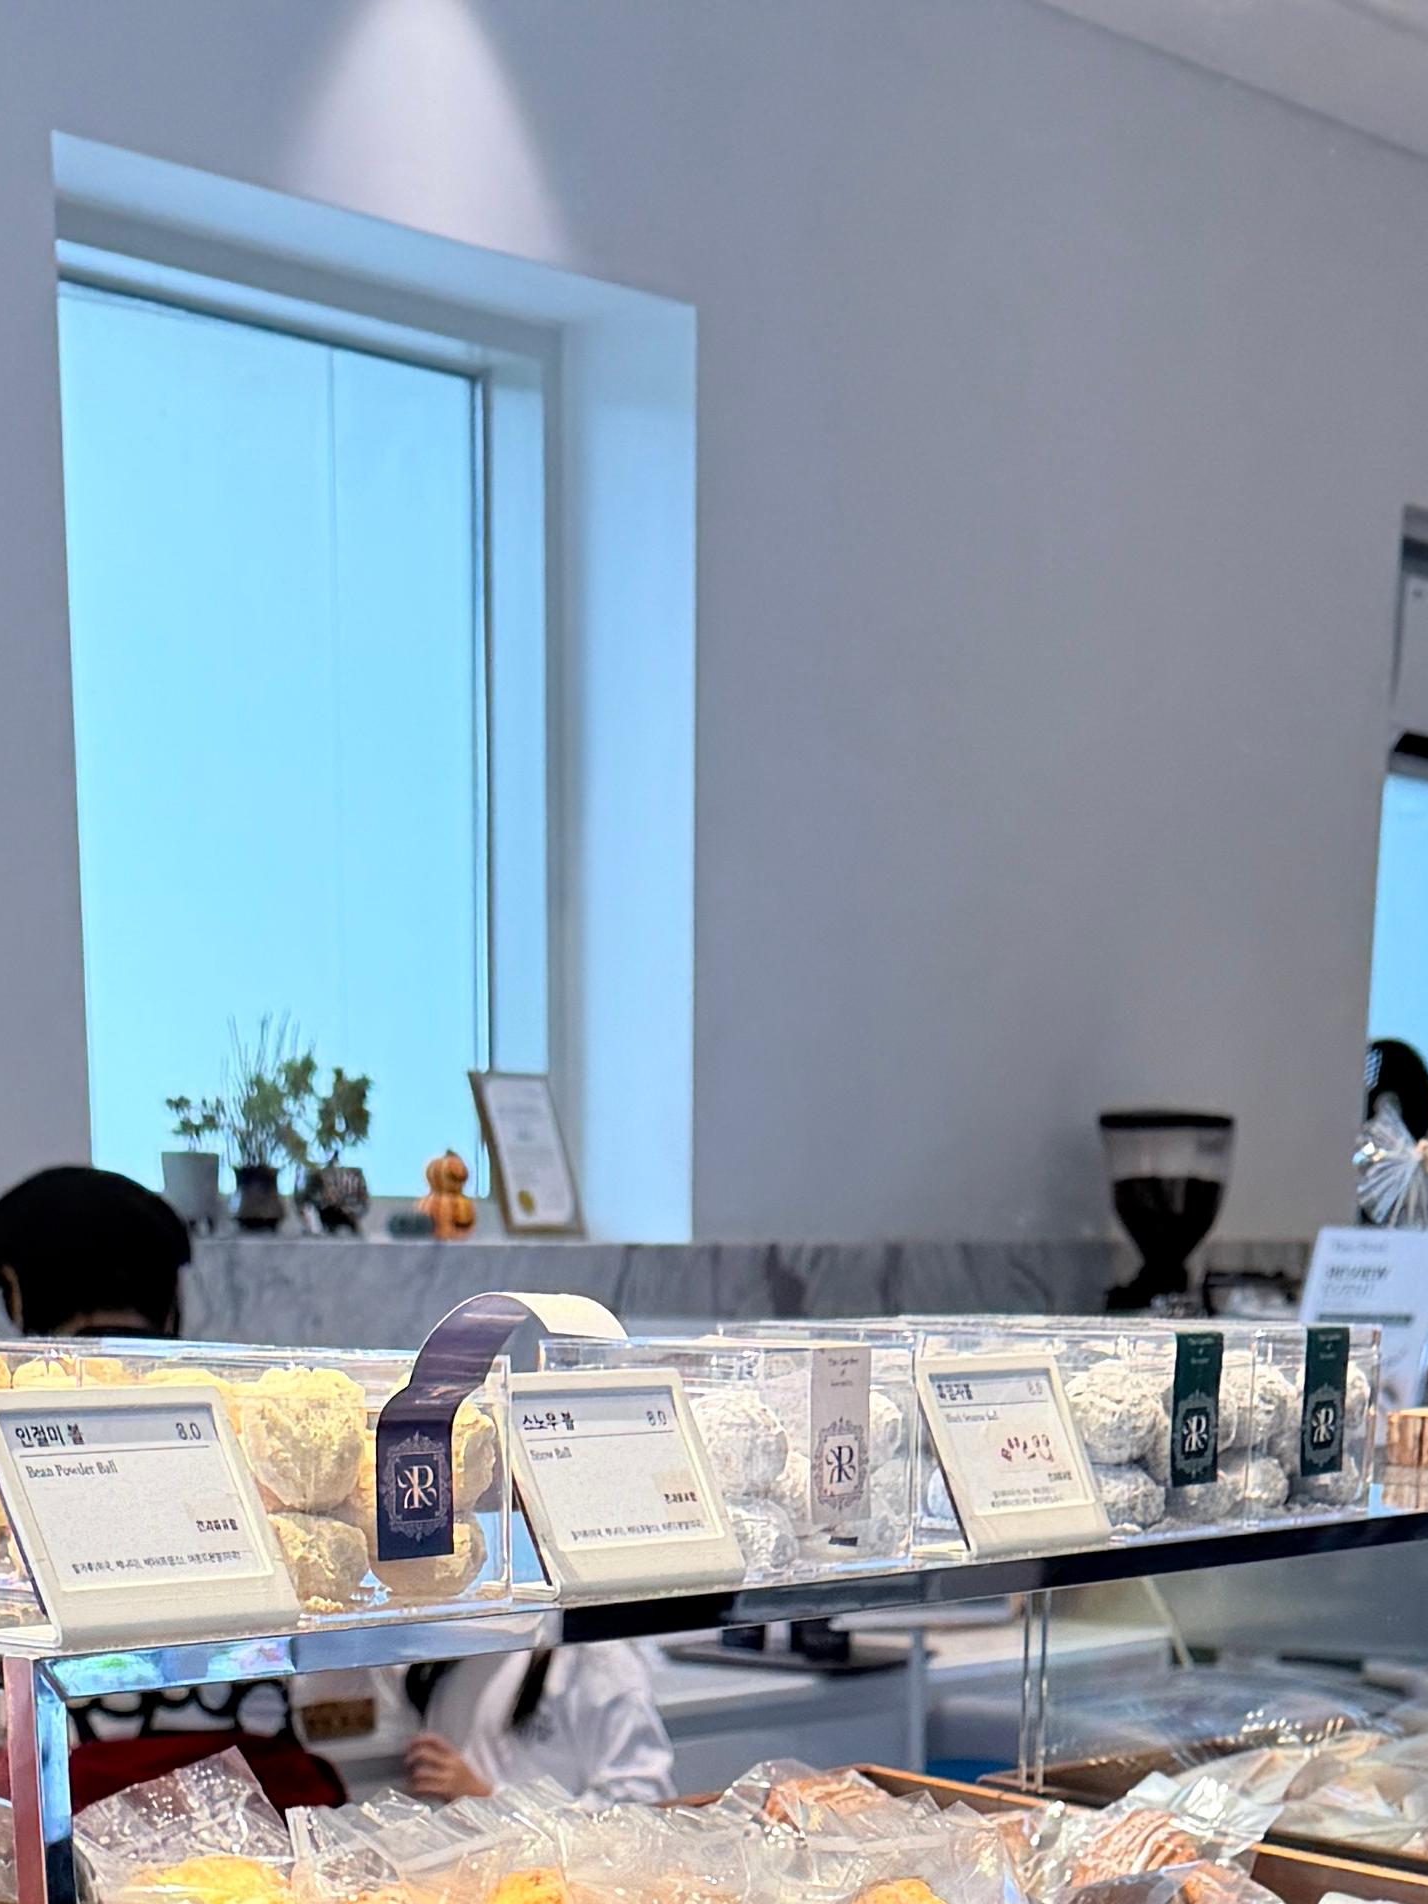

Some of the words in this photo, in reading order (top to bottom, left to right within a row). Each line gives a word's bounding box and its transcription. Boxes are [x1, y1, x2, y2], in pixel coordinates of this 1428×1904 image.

[15, 1423, 64, 1449] 인절미
[175, 1421, 202, 1442] 8.0
[25, 1463, 53, 1479] Bean
[55, 1461, 95, 1477] Powder
[96, 1459, 119, 1474] Ball
